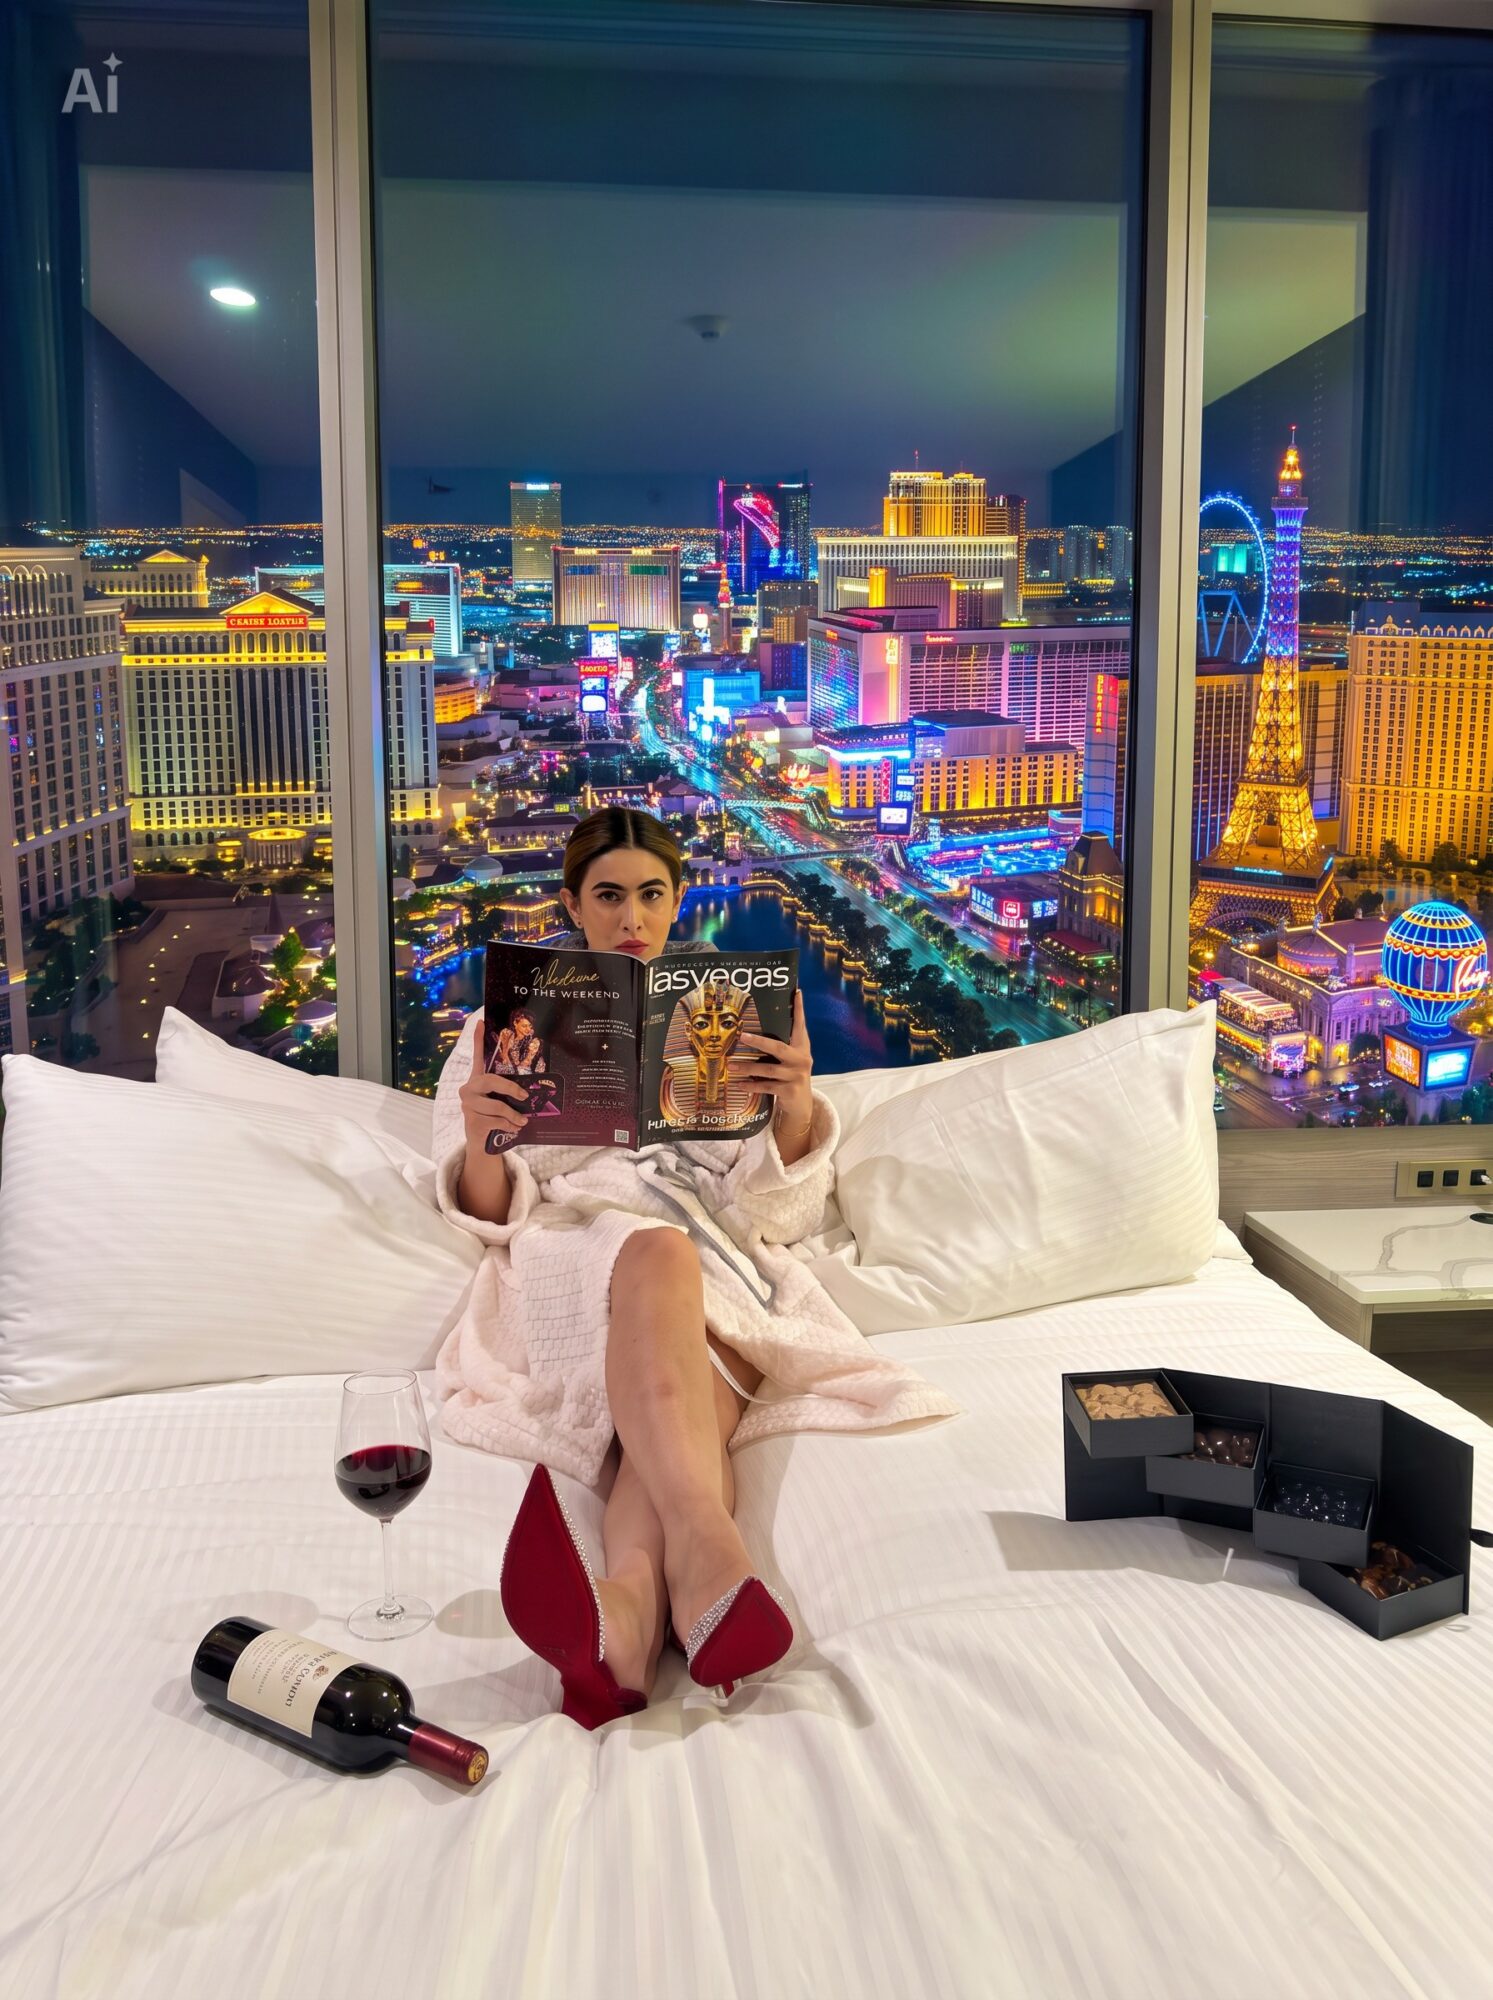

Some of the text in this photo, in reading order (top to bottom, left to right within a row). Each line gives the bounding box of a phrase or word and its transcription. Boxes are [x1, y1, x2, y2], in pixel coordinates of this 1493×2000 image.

[648, 966, 790, 995] lasvegas
[513, 985, 620, 999] TO THE WEEKEND
